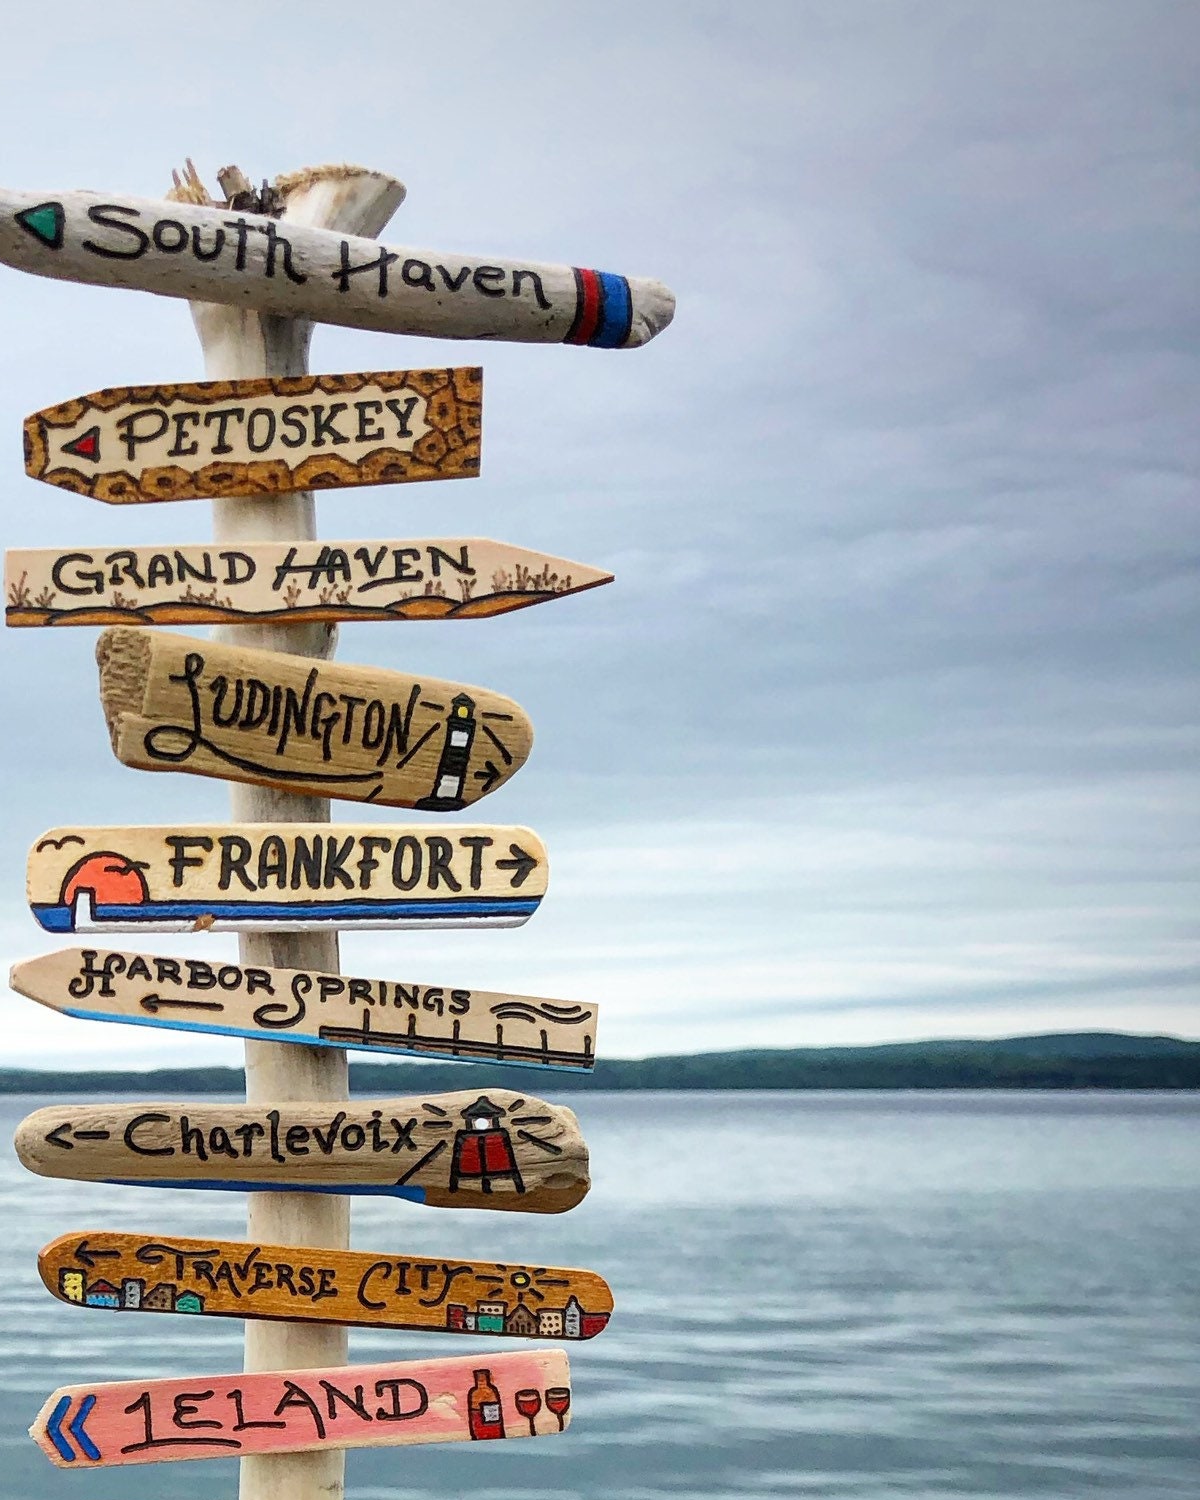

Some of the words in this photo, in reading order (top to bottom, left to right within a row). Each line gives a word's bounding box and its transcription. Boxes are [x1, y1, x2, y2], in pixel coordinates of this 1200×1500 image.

[82, 203, 306, 284] South
[332, 240, 553, 309] Haven
[117, 397, 419, 461] PETOSKEY
[51, 552, 257, 595] GRAND
[271, 545, 475, 592] HAVEN
[144, 652, 421, 782] LUDINGTON
[165, 834, 494, 892] FRANKFORT
[68, 950, 275, 998] HARBOR
[253, 979, 471, 1028] SPRINGS
[122, 1110, 420, 1163] Charlevoix
[136, 1243, 339, 1299] TRAVERSE
[357, 1261, 473, 1309] CITY
